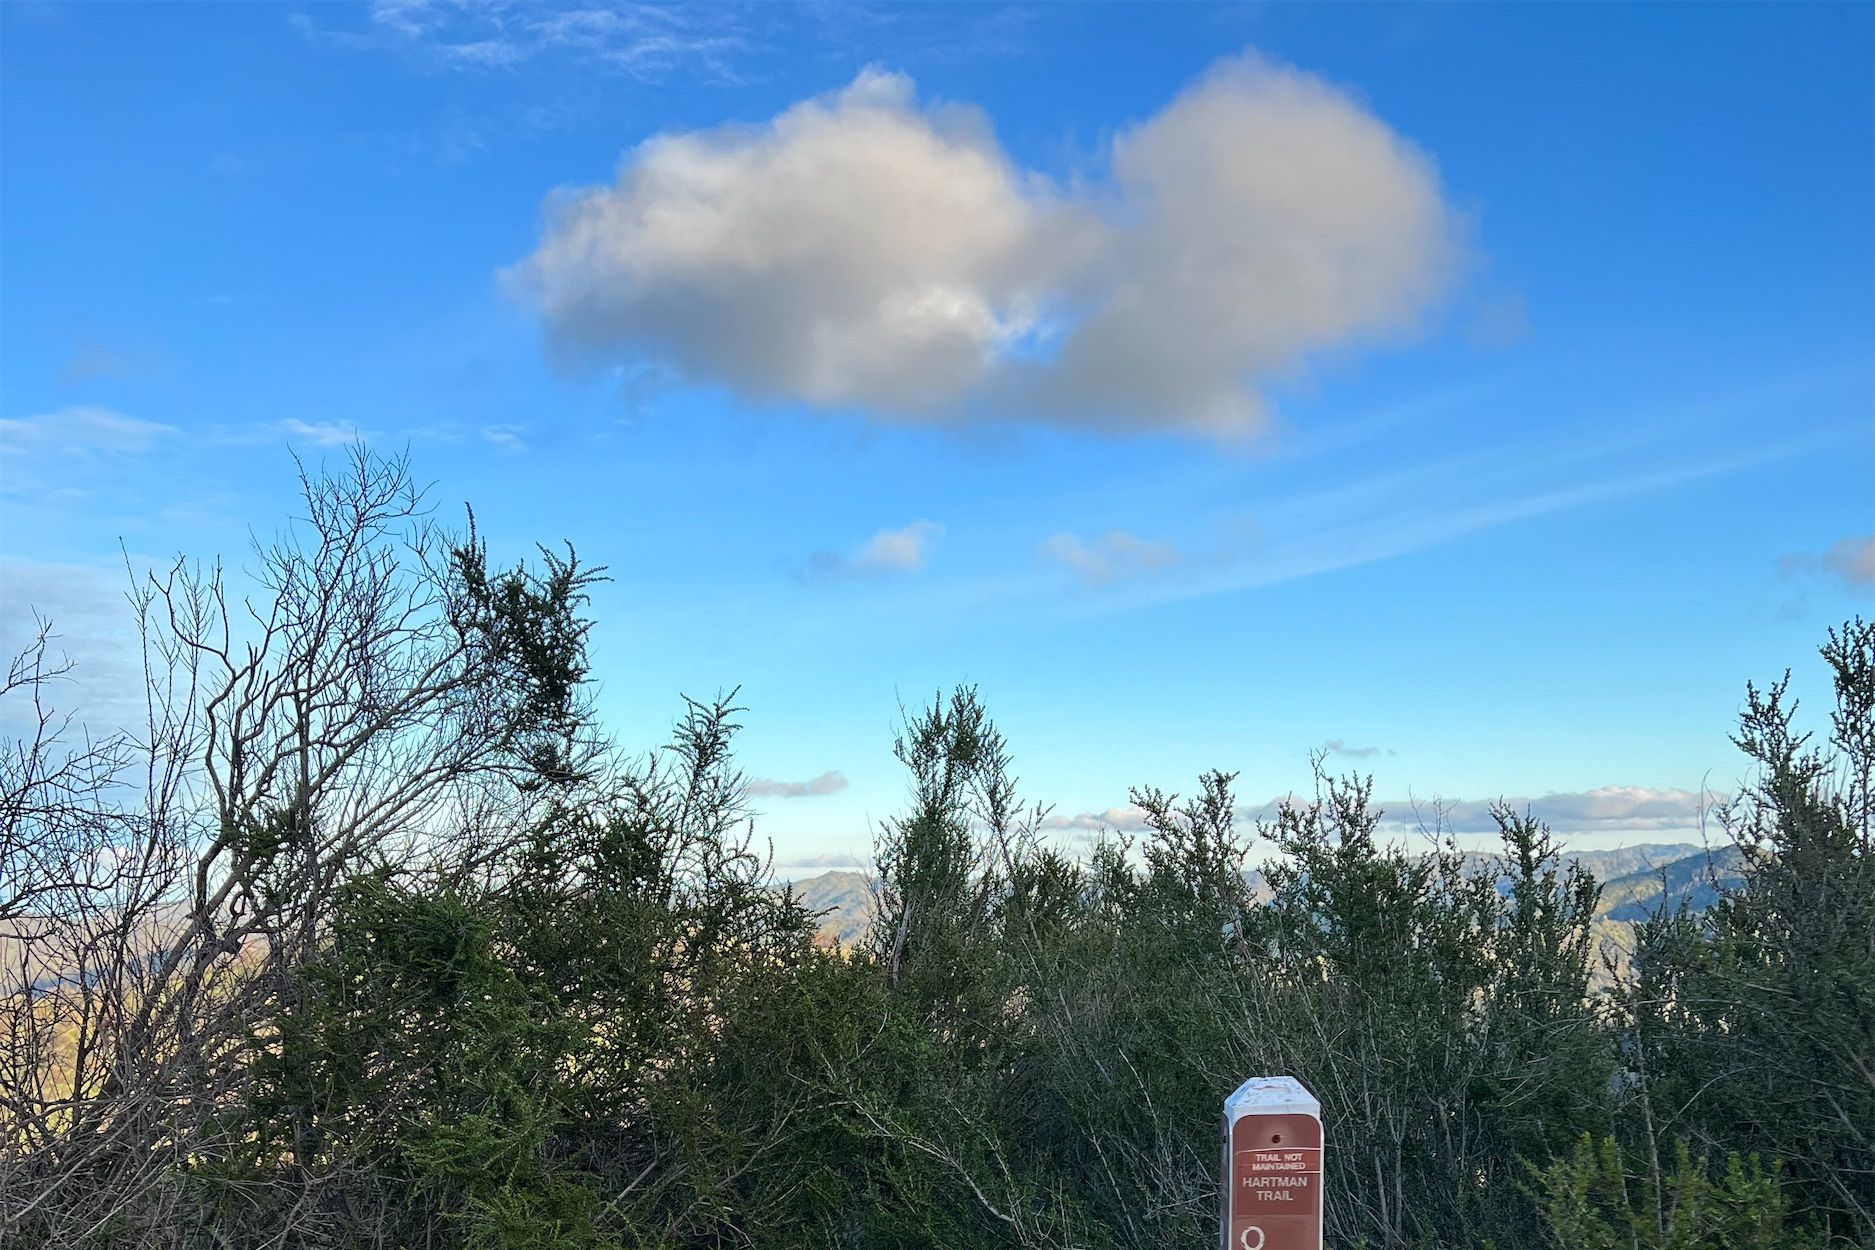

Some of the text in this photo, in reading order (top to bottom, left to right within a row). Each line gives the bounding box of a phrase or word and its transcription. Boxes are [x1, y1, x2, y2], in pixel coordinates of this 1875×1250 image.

[1255, 1153, 1303, 1161] TRAIL NOT
[1252, 1162, 1306, 1171] MAINTAINED
[1242, 1177, 1308, 1187] HARTMAN
[1256, 1190, 1293, 1201] TRAIL
